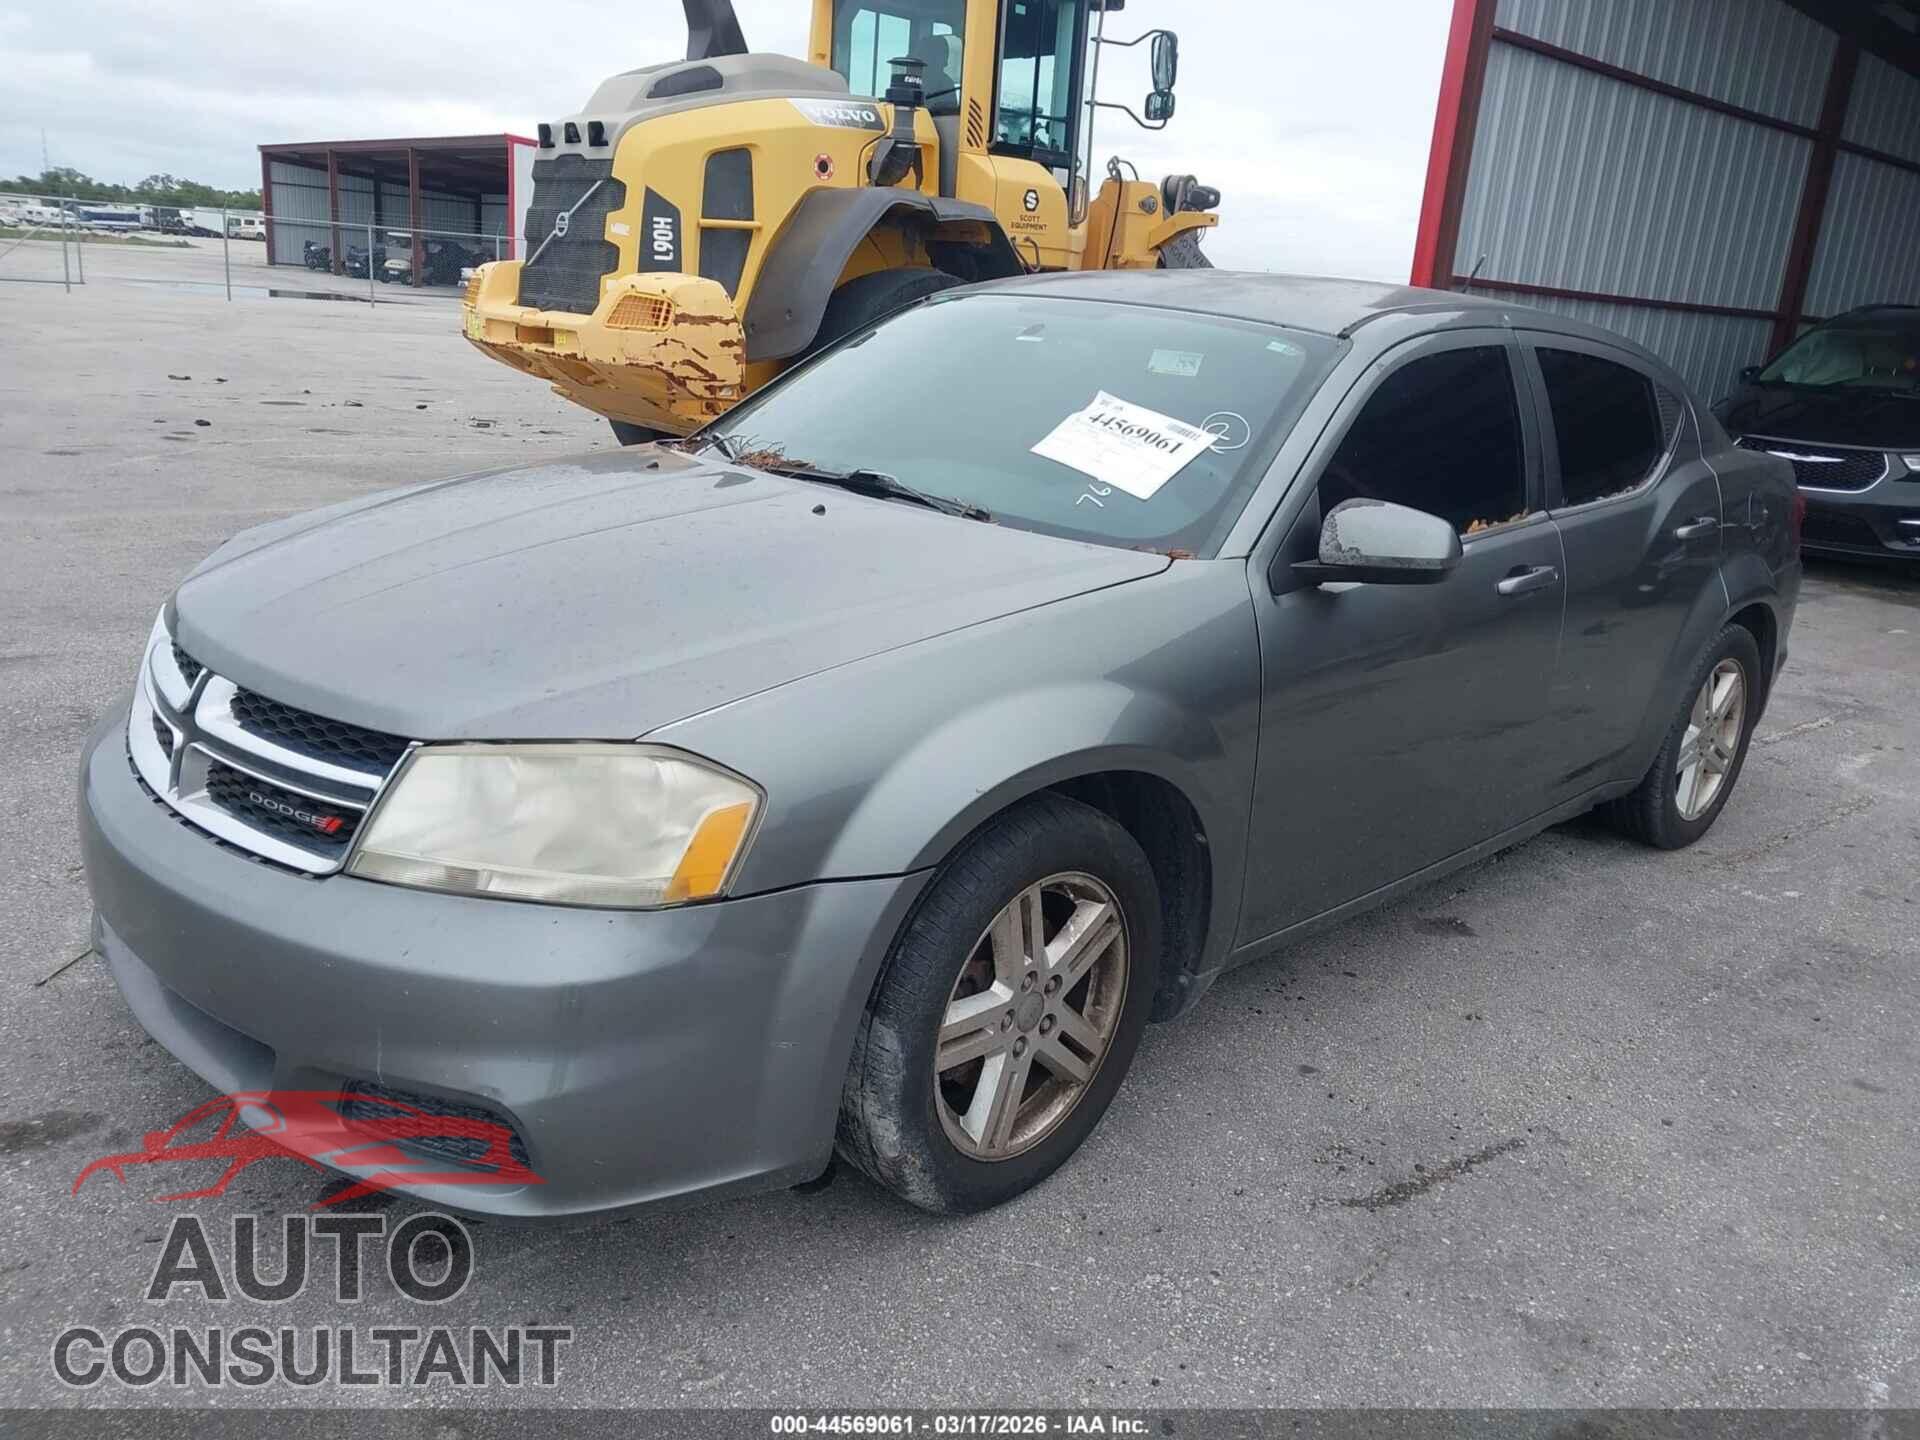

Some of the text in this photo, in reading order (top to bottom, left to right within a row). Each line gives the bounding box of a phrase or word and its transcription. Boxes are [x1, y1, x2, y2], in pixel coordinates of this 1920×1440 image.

[811, 106, 876, 122] VOLVO
[652, 216, 674, 261] L90H
[1011, 222, 1047, 231] EQUIPMENT
[1088, 412, 1184, 454] 44569061
[249, 791, 328, 828] DODGE
